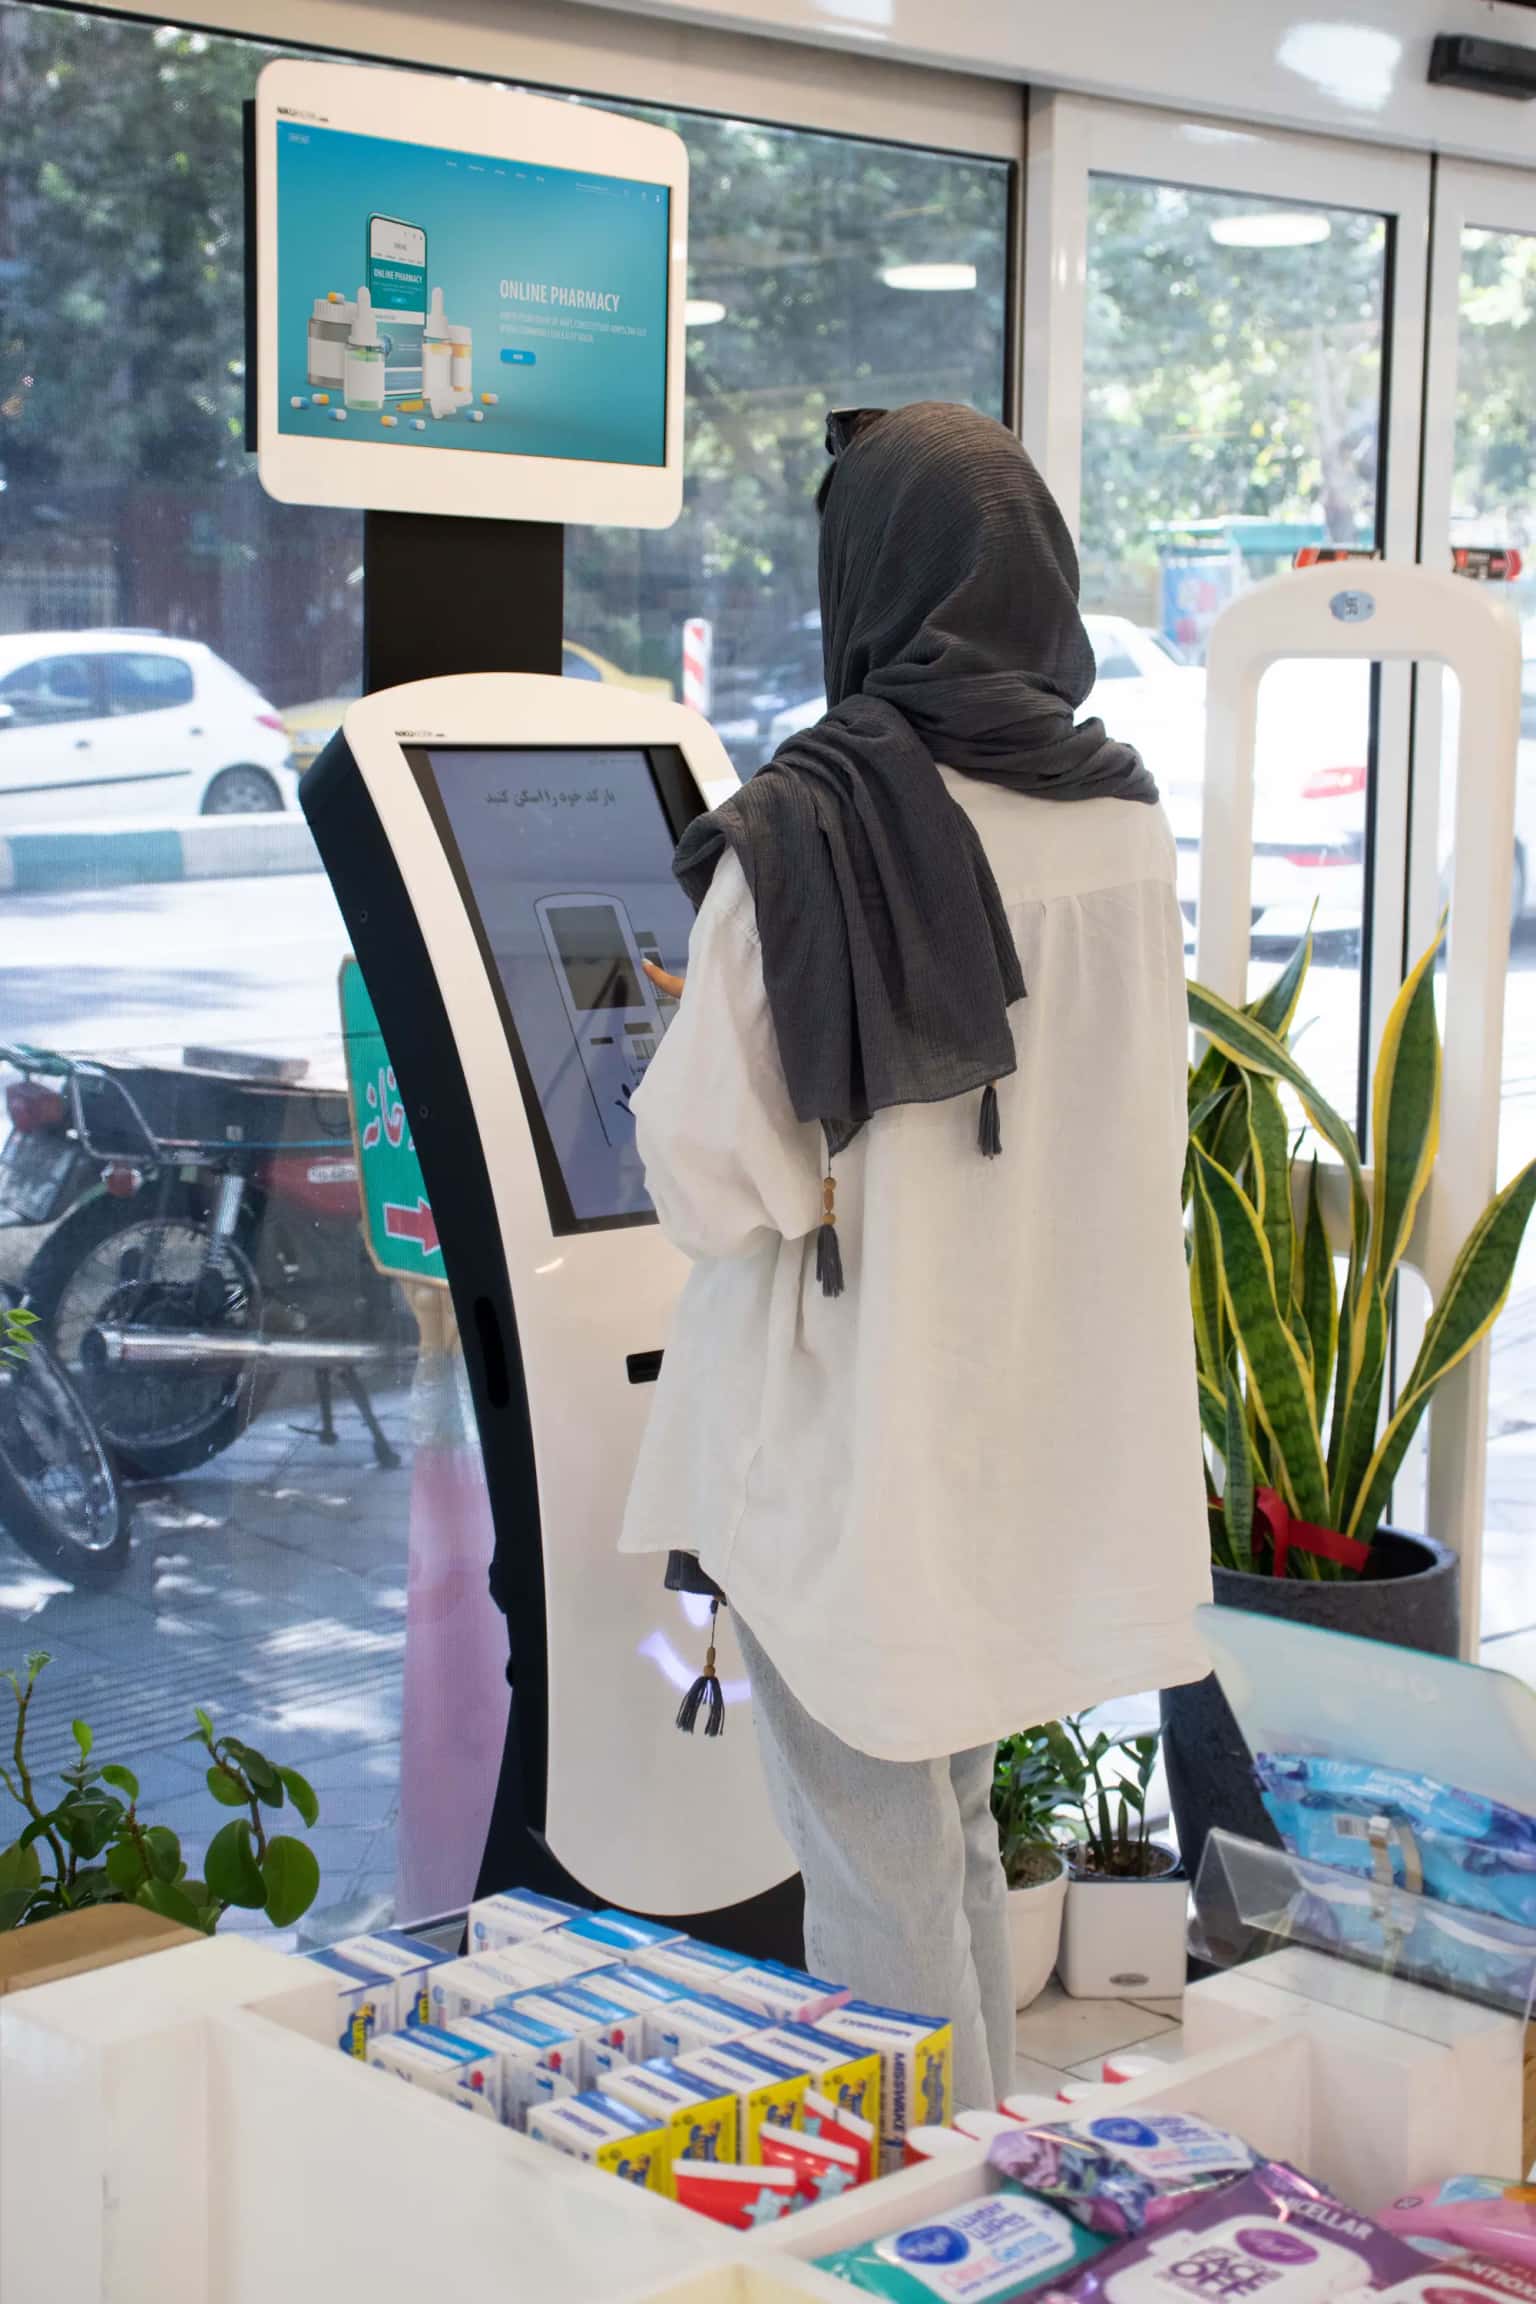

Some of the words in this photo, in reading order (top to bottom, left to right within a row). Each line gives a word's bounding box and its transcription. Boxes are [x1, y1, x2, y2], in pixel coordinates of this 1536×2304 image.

[500, 279, 548, 304] ONLINE
[550, 285, 621, 313] PHARMACY
[893, 2051, 906, 2132] MISSWAKE
